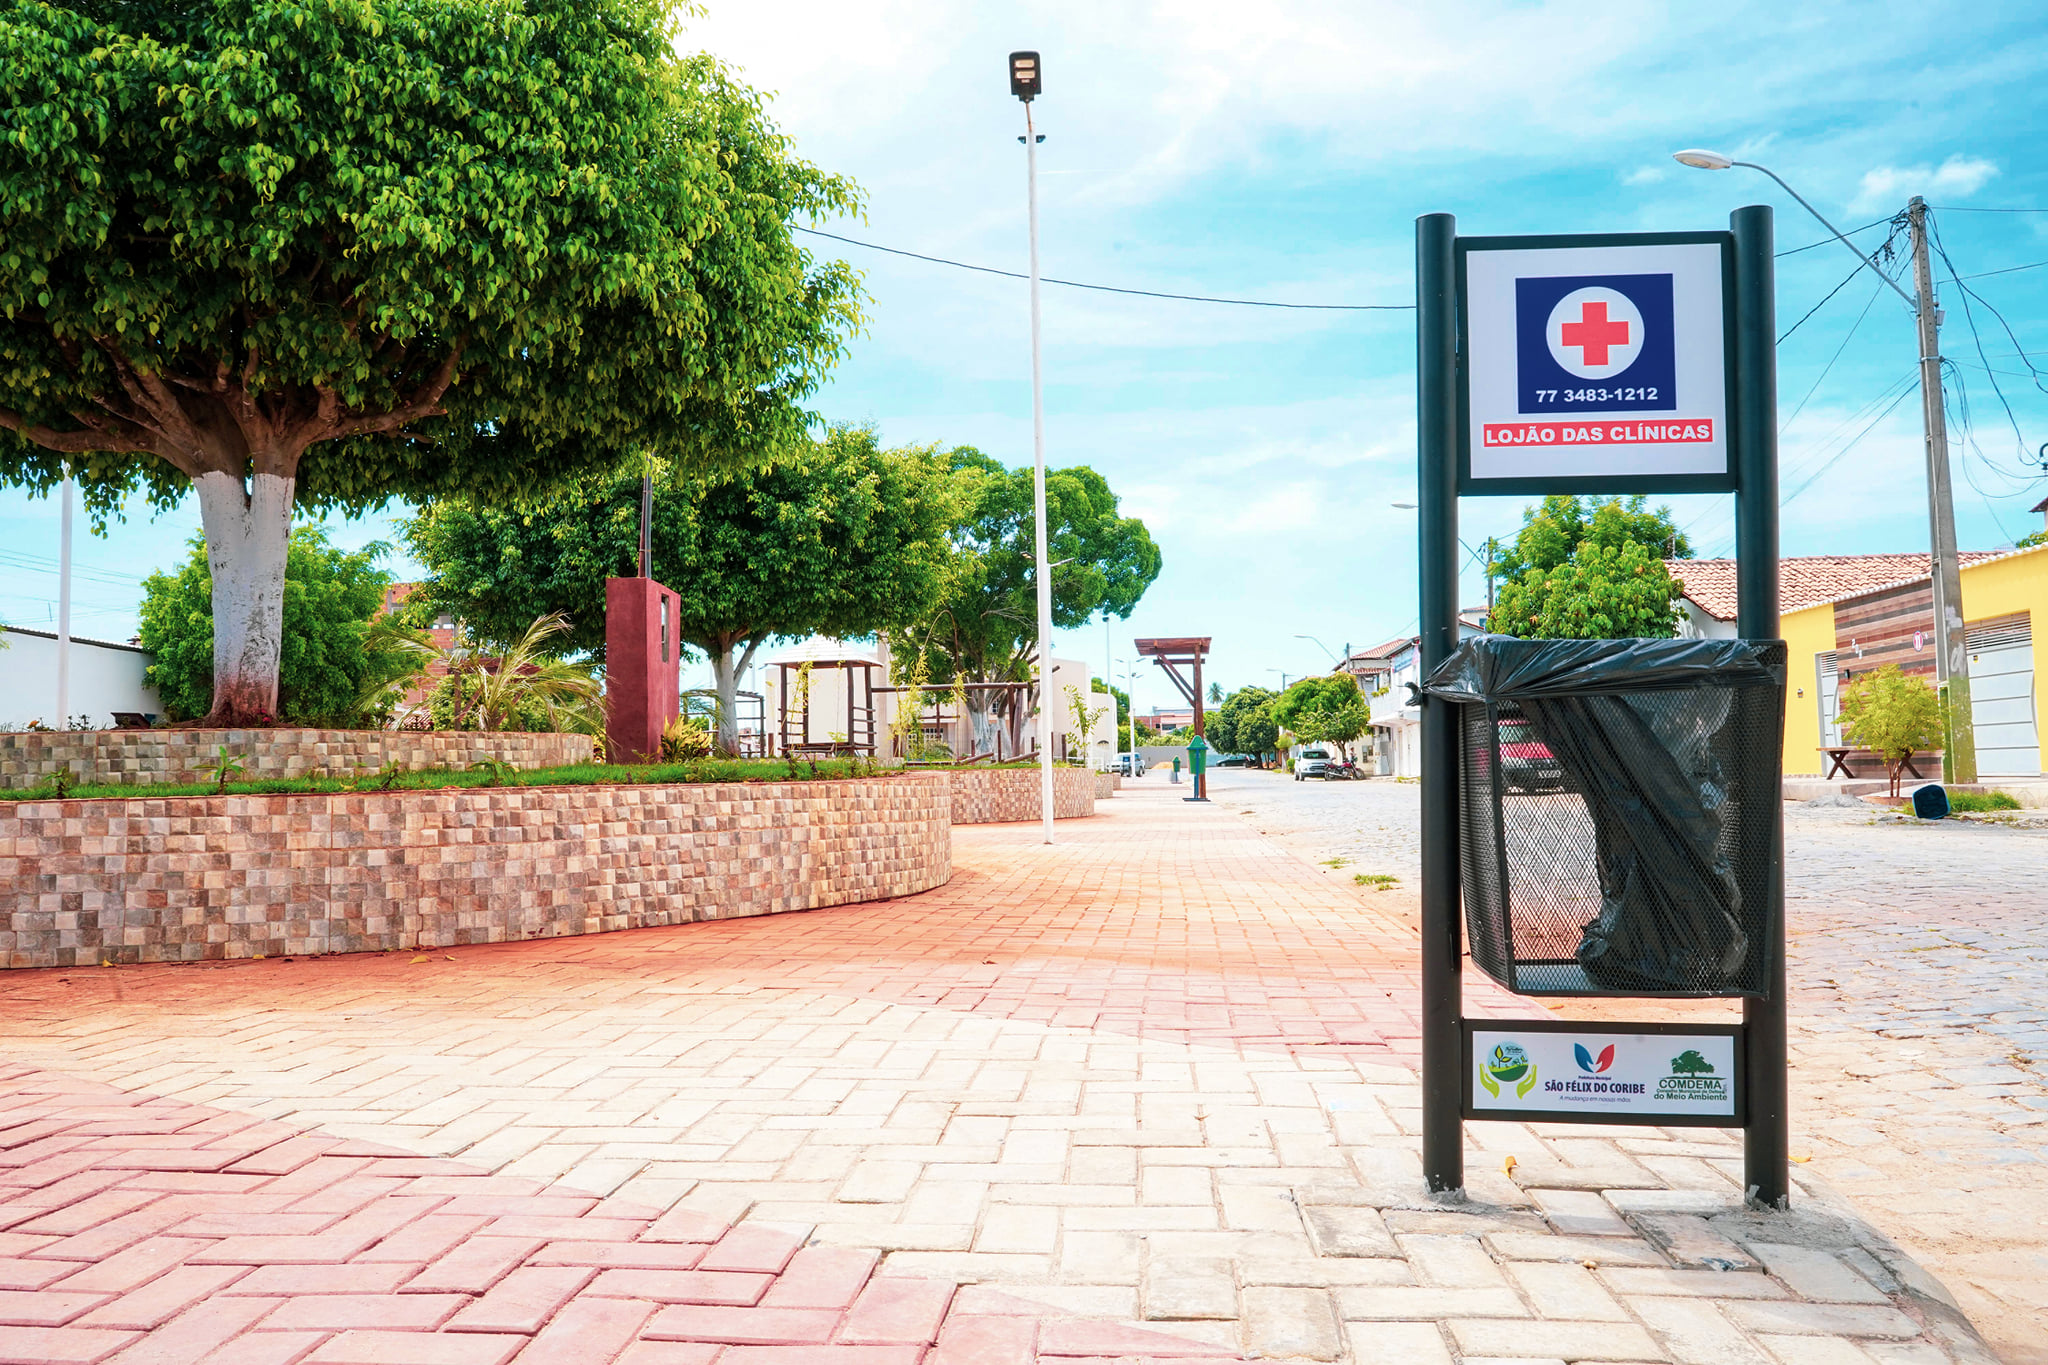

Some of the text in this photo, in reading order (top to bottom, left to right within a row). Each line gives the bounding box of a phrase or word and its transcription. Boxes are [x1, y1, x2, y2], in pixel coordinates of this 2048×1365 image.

[1535, 387, 1659, 403] 77 3483-1212
[1486, 423, 1710, 444] LOJÃO DAS CLÍNICAS
[1544, 1079, 1646, 1094] SÃO FÉLIX DO CORIBE
[1659, 1079, 1722, 1089] COMDEMA
[1654, 1092, 1665, 1100] do
[1688, 1093, 1728, 1101] Ambiente
